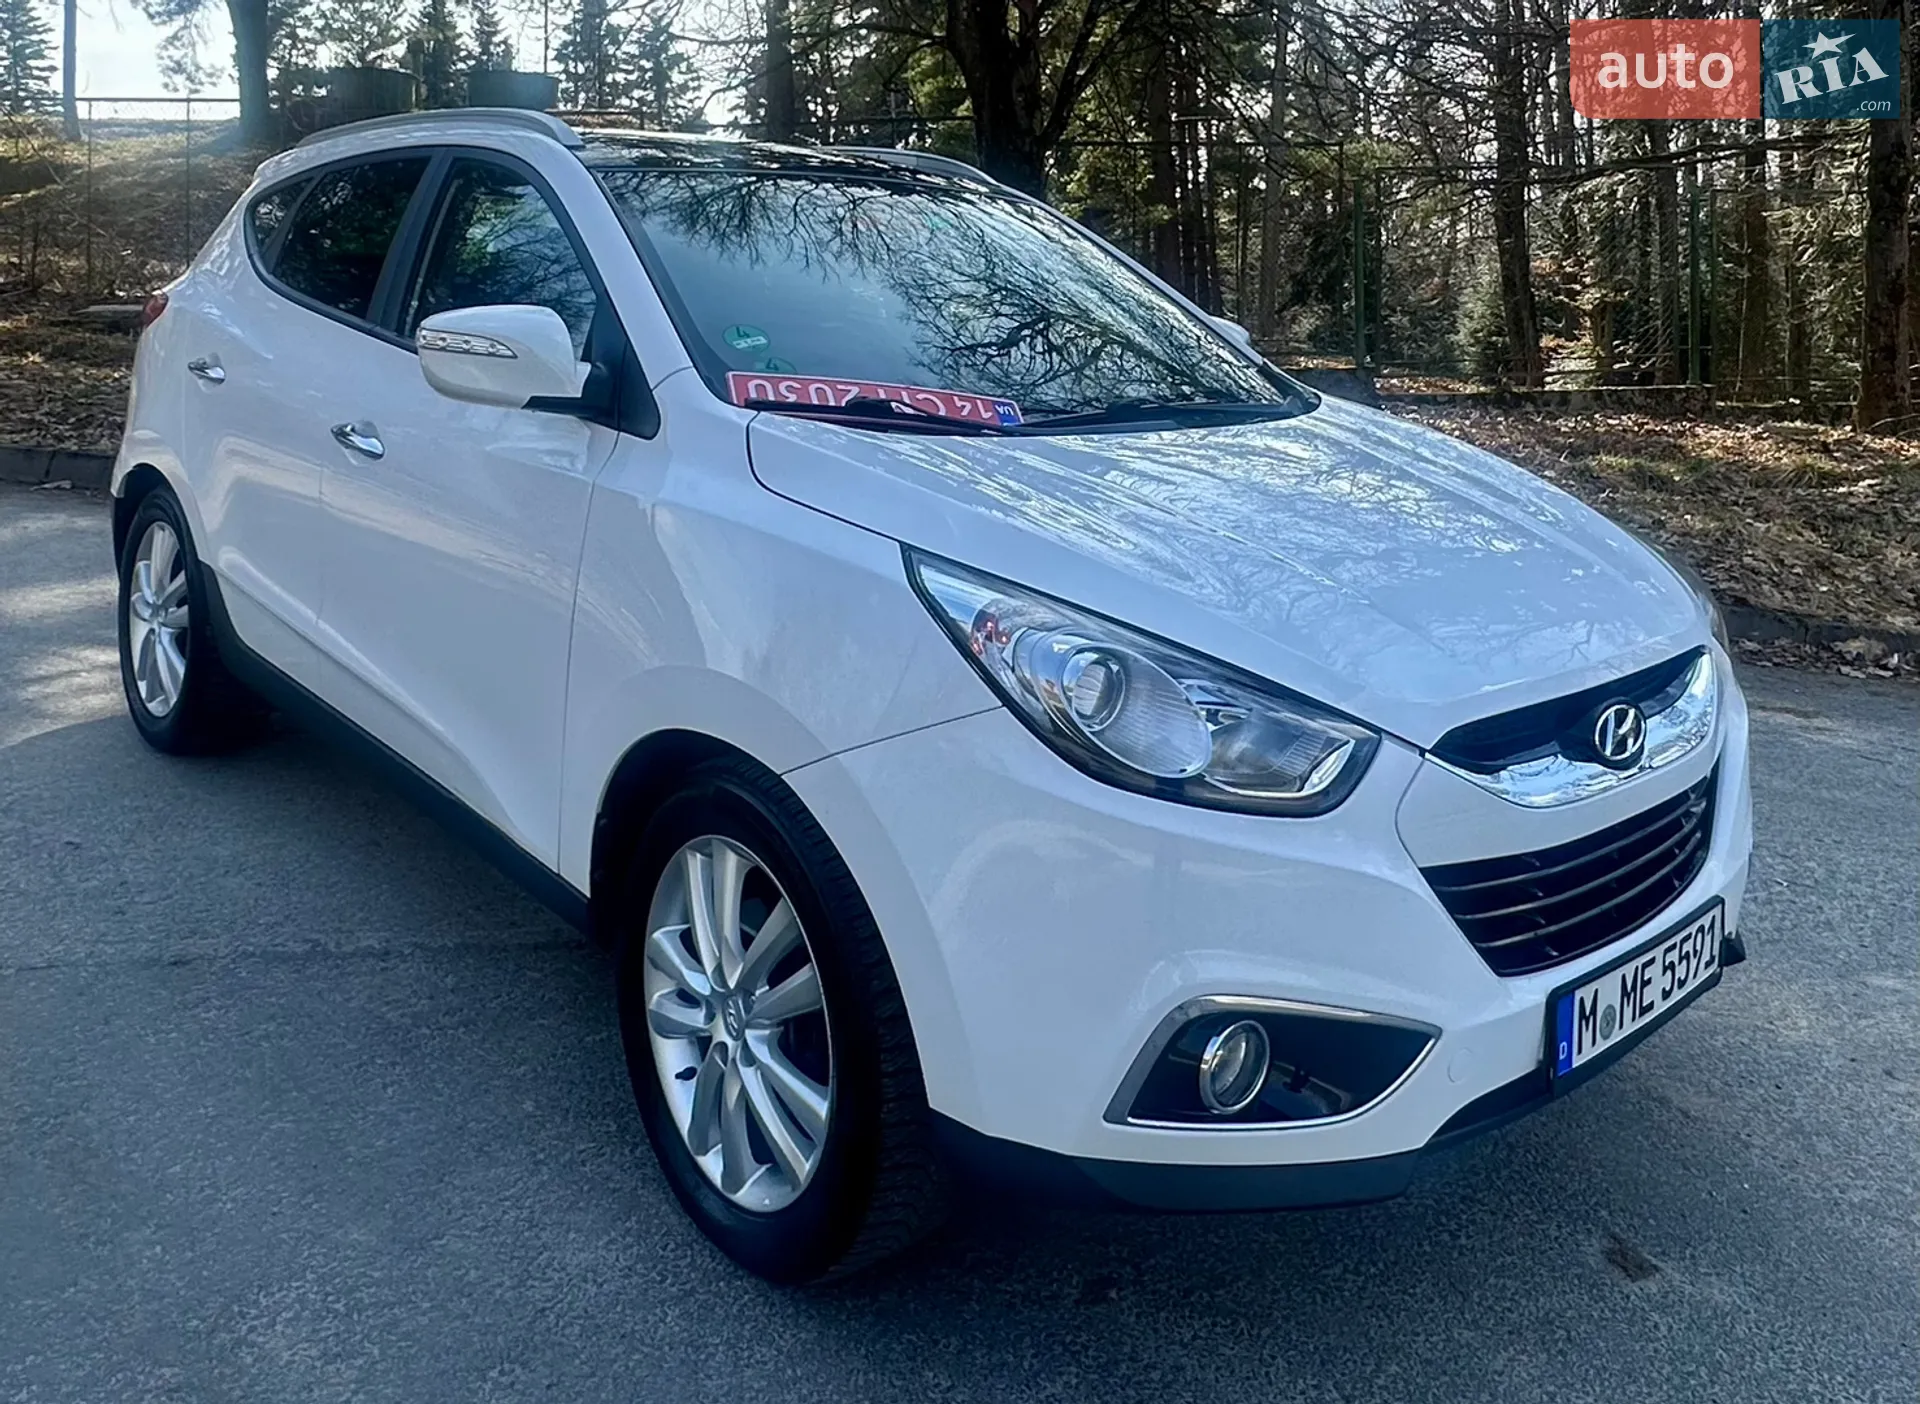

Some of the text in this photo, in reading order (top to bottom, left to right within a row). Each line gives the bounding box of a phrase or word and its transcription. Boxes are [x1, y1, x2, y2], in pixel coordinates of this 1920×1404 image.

[735, 325, 751, 339] 4
[952, 395, 993, 419] 14
[994, 404, 1015, 416] UA
[1576, 914, 1717, 1056] M ME 5591
[1558, 1041, 1568, 1061] D
